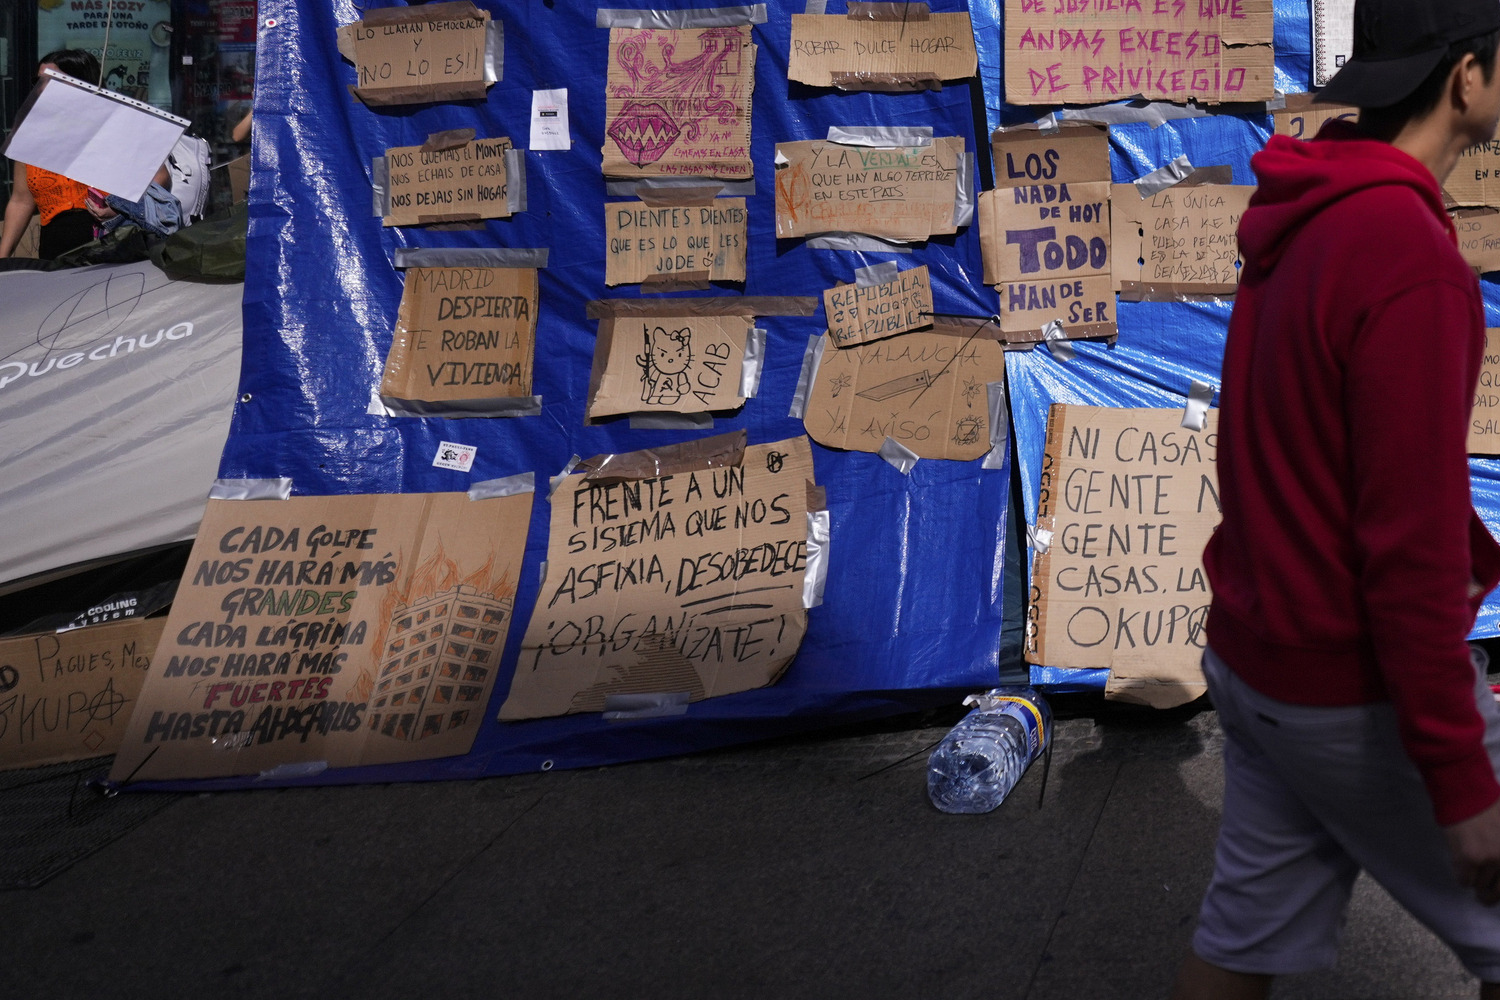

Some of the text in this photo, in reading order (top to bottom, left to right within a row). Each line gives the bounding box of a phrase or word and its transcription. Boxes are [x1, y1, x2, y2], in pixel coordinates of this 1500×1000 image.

[83, 11, 134, 21] PARA UNA
[107, 0, 146, 12] COZY
[66, 20, 149, 31] TARDE DE OTOÑO
[793, 35, 962, 58] ROBAR DULCE HOGAR
[1018, 26, 1221, 60] ANDAS EXCESO
[1027, 62, 1070, 96] DE
[1006, 149, 1060, 180] LOS
[1013, 183, 1072, 205] NADA
[1040, 203, 1103, 223] DE HOY
[1008, 281, 1084, 312] HAN DE
[0, 321, 194, 389] Quechua
[572, 464, 746, 528] FRENTE A UN
[568, 493, 791, 554] SISTEMA QUE NOS
[219, 524, 378, 558] CADA GOLPE
[193, 551, 397, 587] NOS HARÁ MÁS
[548, 553, 671, 609] ASFIXIA,
[87, 598, 138, 617] COOLING
[221, 587, 358, 623] GRANDES
[176, 621, 248, 648] CADA
[163, 645, 349, 679] NOS HARÁ MÁS
[203, 676, 334, 710] FUERTES
[143, 708, 247, 744] HASTA
